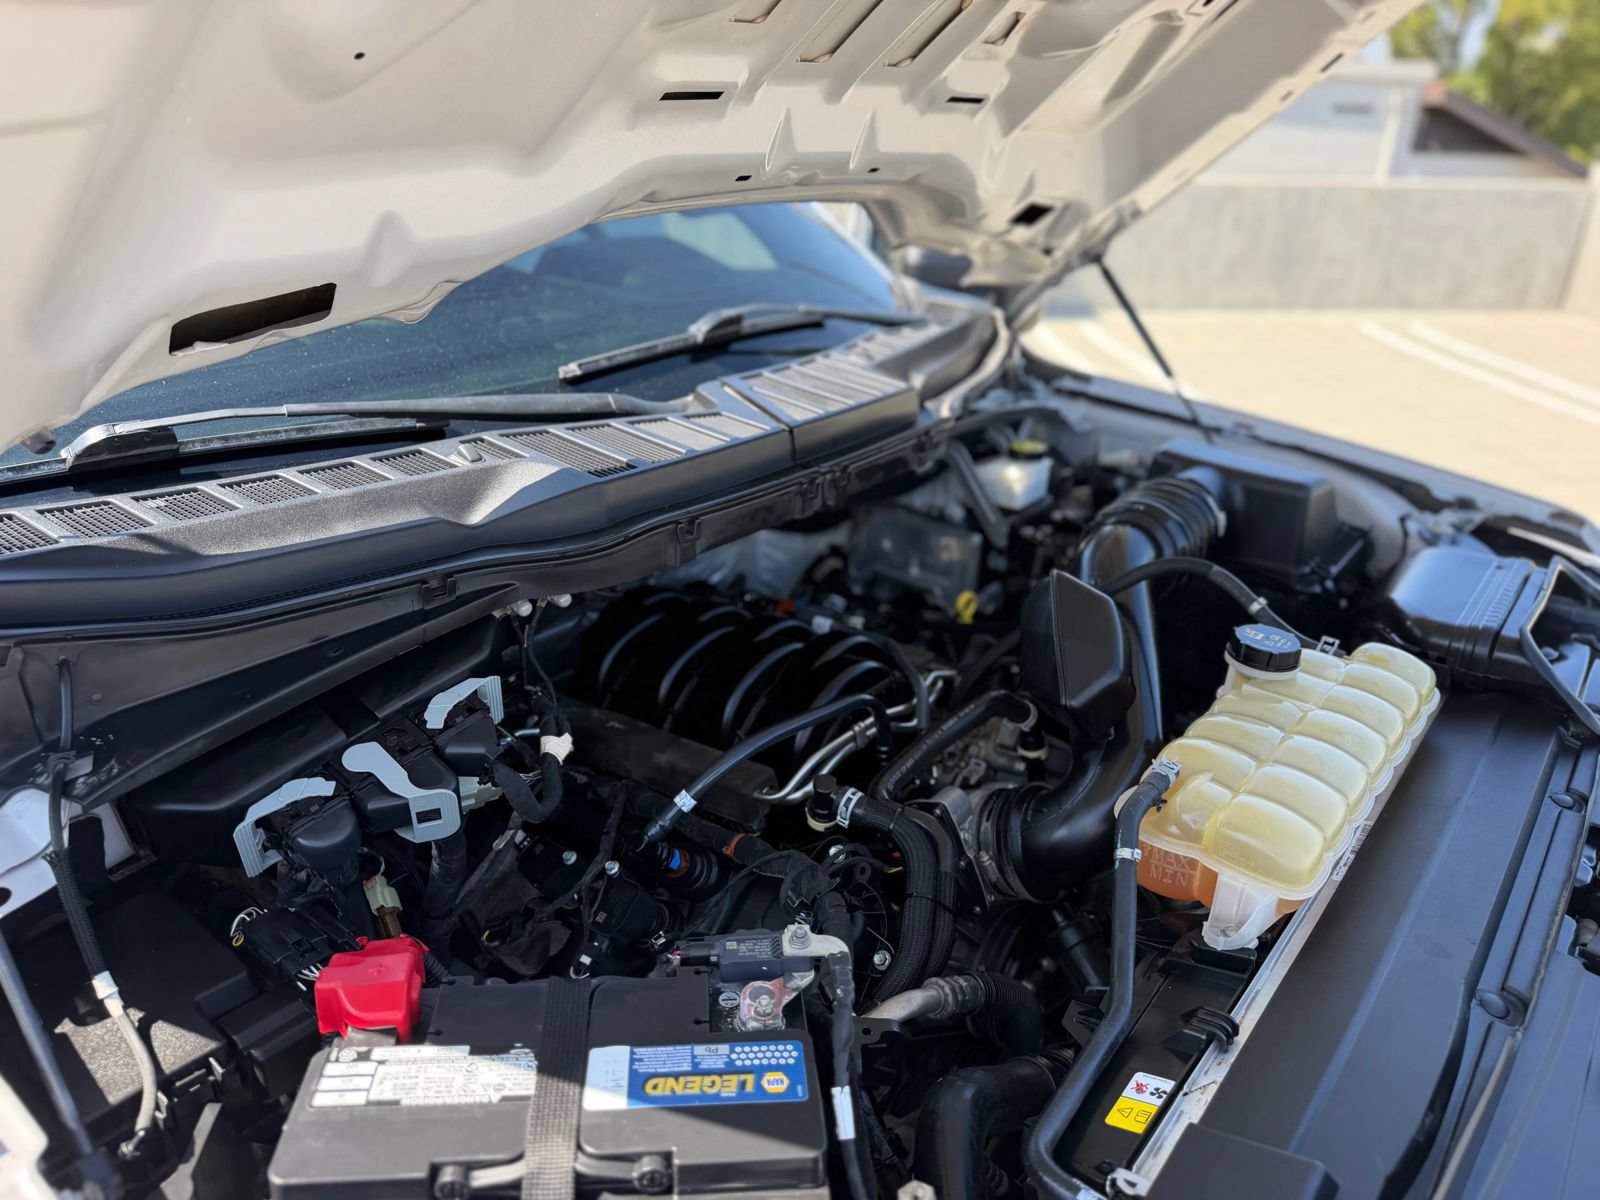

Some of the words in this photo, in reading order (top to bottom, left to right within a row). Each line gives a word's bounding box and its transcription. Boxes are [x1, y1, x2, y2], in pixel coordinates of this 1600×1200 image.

[1151, 847, 1190, 870] MAX
[1150, 863, 1188, 887] MIN
[704, 1046, 719, 1054] Pb
[644, 1074, 755, 1095] LEGEND
[766, 1078, 785, 1087] NAPA
